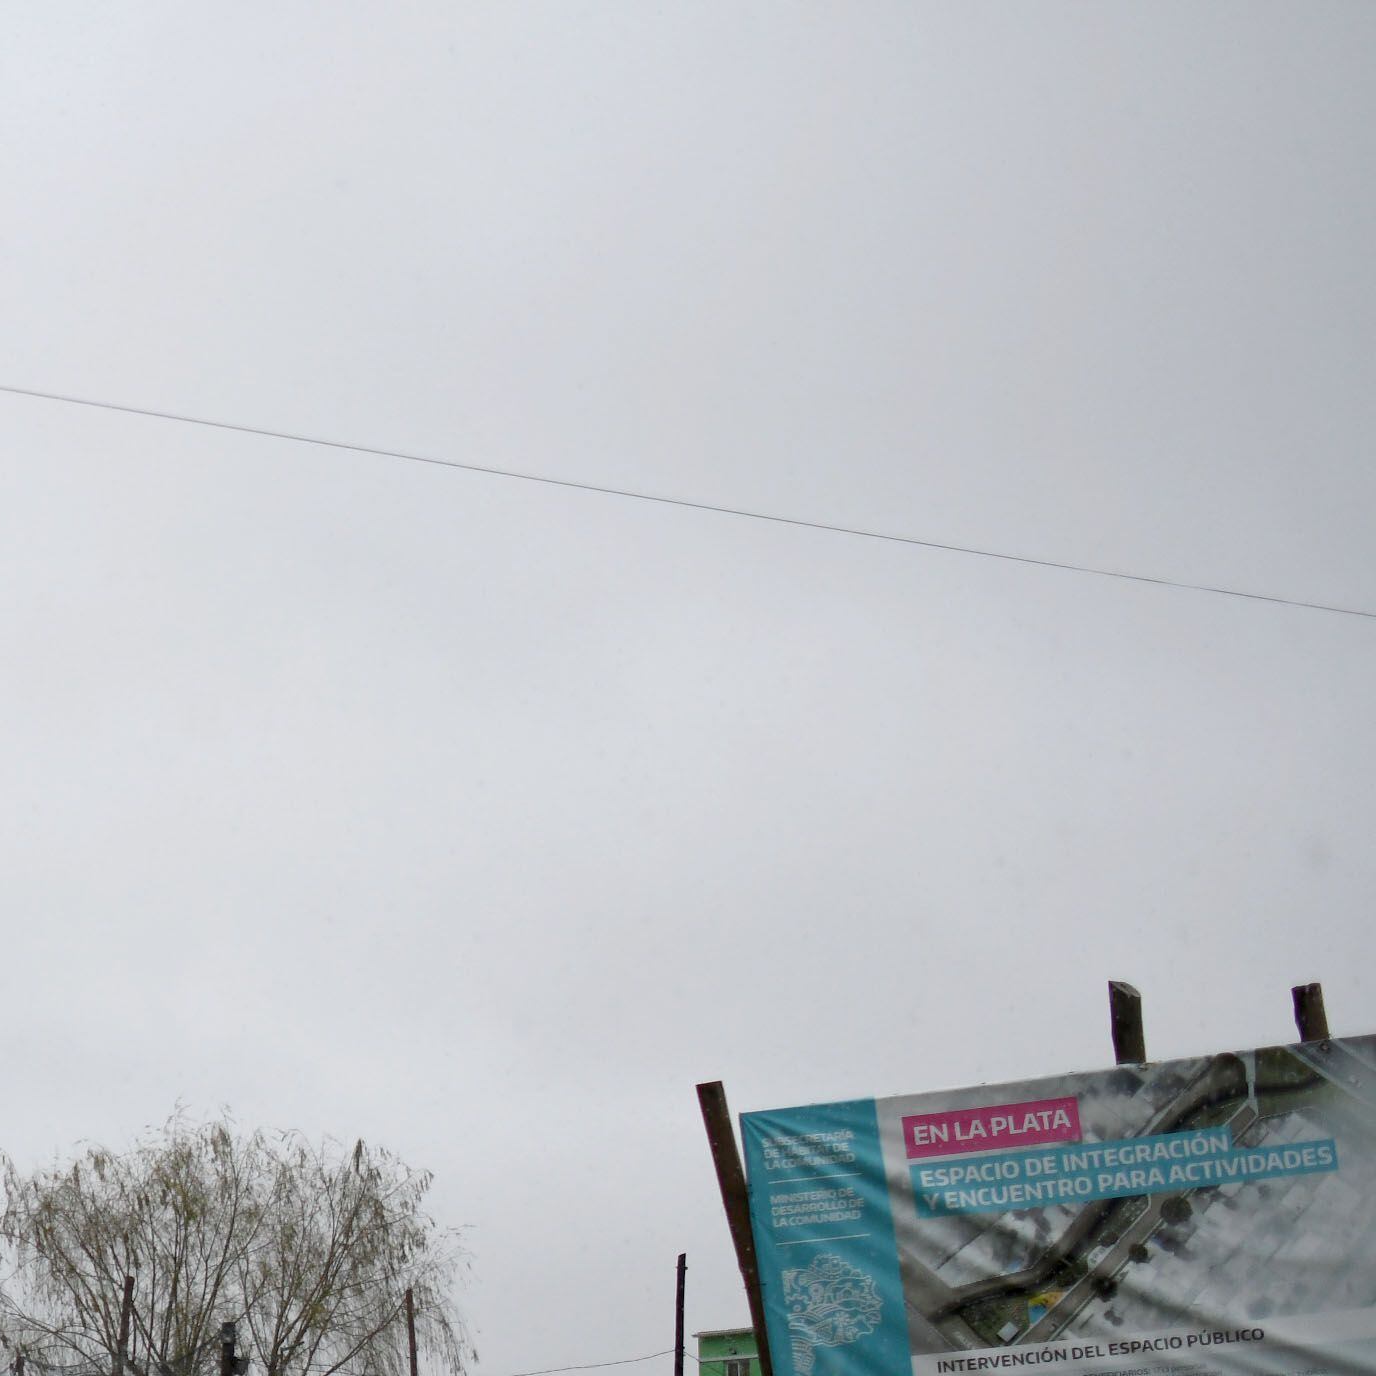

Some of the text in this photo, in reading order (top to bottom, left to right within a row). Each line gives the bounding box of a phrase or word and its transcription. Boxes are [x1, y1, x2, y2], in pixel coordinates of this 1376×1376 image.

[913, 1109, 1072, 1146] EN LA PLATA
[764, 1149, 779, 1159] DE
[832, 1142, 849, 1152] DE
[920, 1132, 1229, 1187] ESPACIO DE INTEGRACIÓN
[767, 1153, 856, 1170] LA COMUNIDAD
[924, 1146, 1333, 1210] Y ENCUENTRO PARA ACTIVIDADES
[770, 1187, 855, 1205] MINISTERIO DE
[772, 1198, 865, 1217] DESARROLLO DE
[774, 1210, 861, 1228] LA COMUNIDAD
[937, 1327, 1265, 1374] INTERVENCIÓN DEL ESPACIO PÚBLICO
